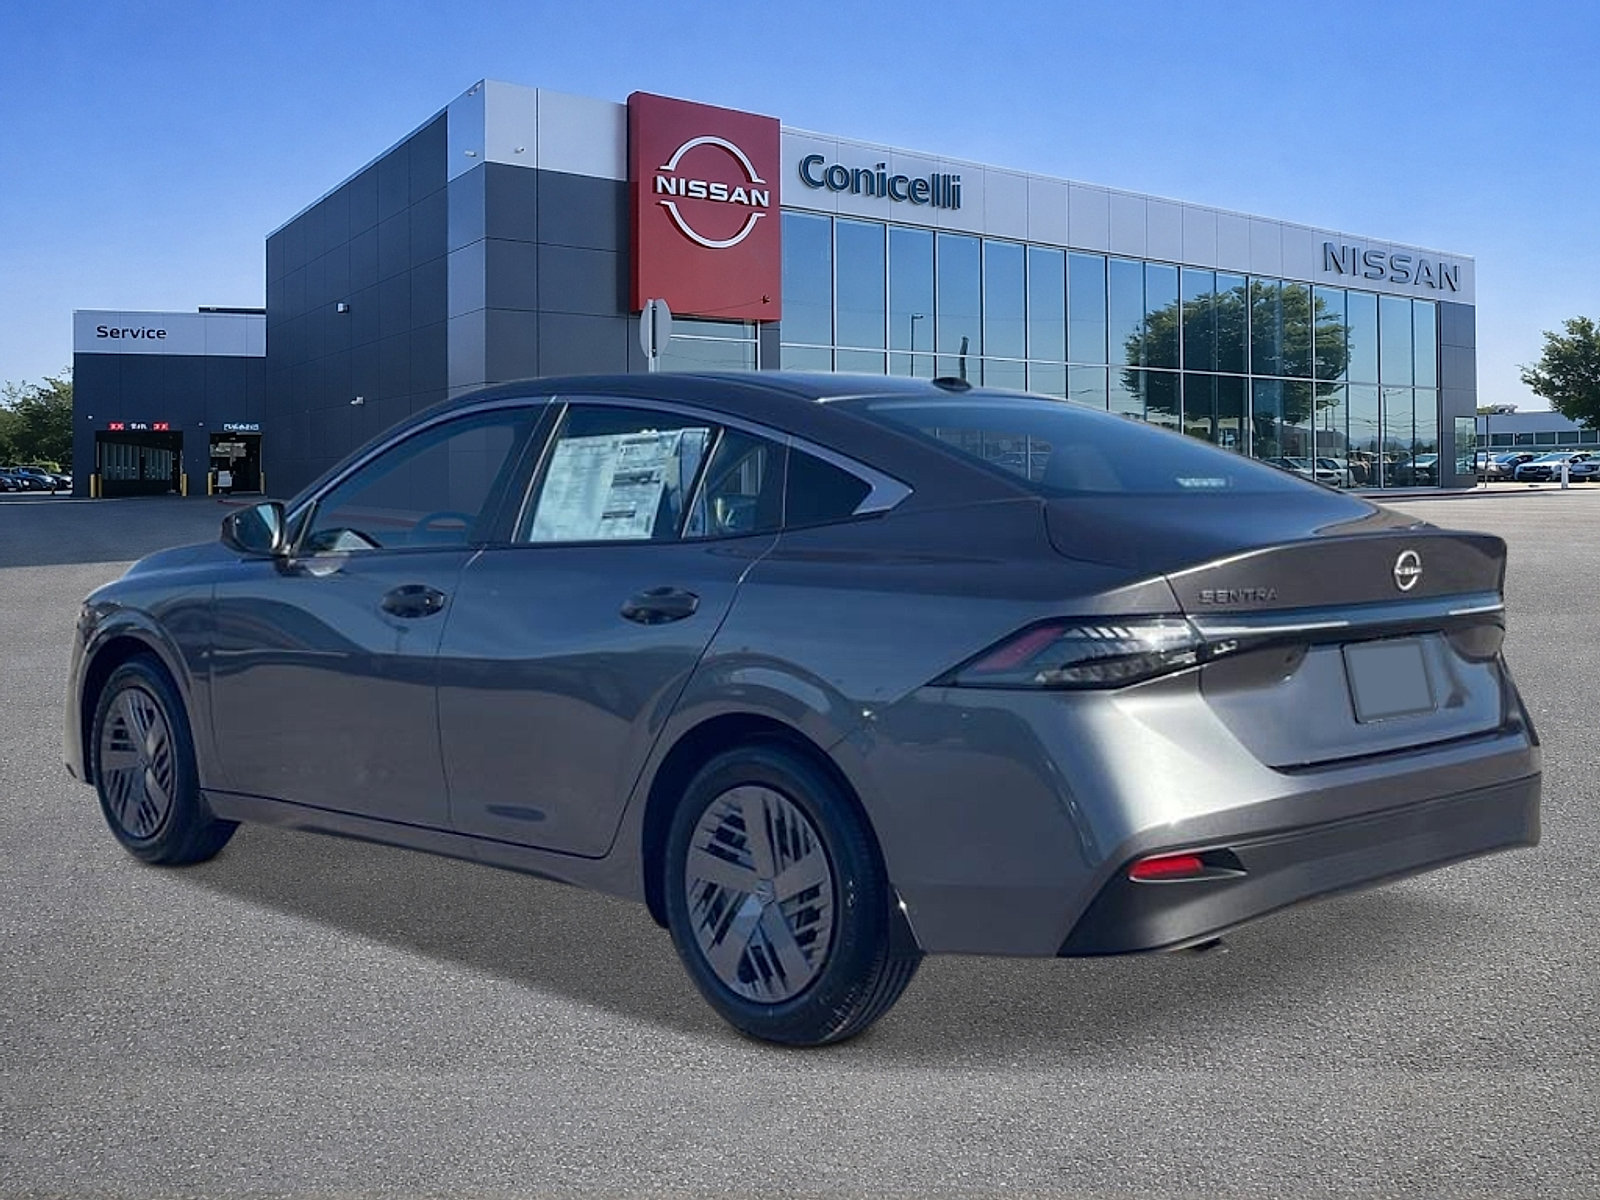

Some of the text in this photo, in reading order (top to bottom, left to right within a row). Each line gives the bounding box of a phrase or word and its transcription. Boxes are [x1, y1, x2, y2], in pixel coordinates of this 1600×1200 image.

[655, 175, 769, 208] NISSAN
[799, 154, 961, 210] Conicelli
[1323, 242, 1461, 292] NISSAN
[96, 325, 167, 339] Service
[1199, 587, 1278, 603] SENTRA
